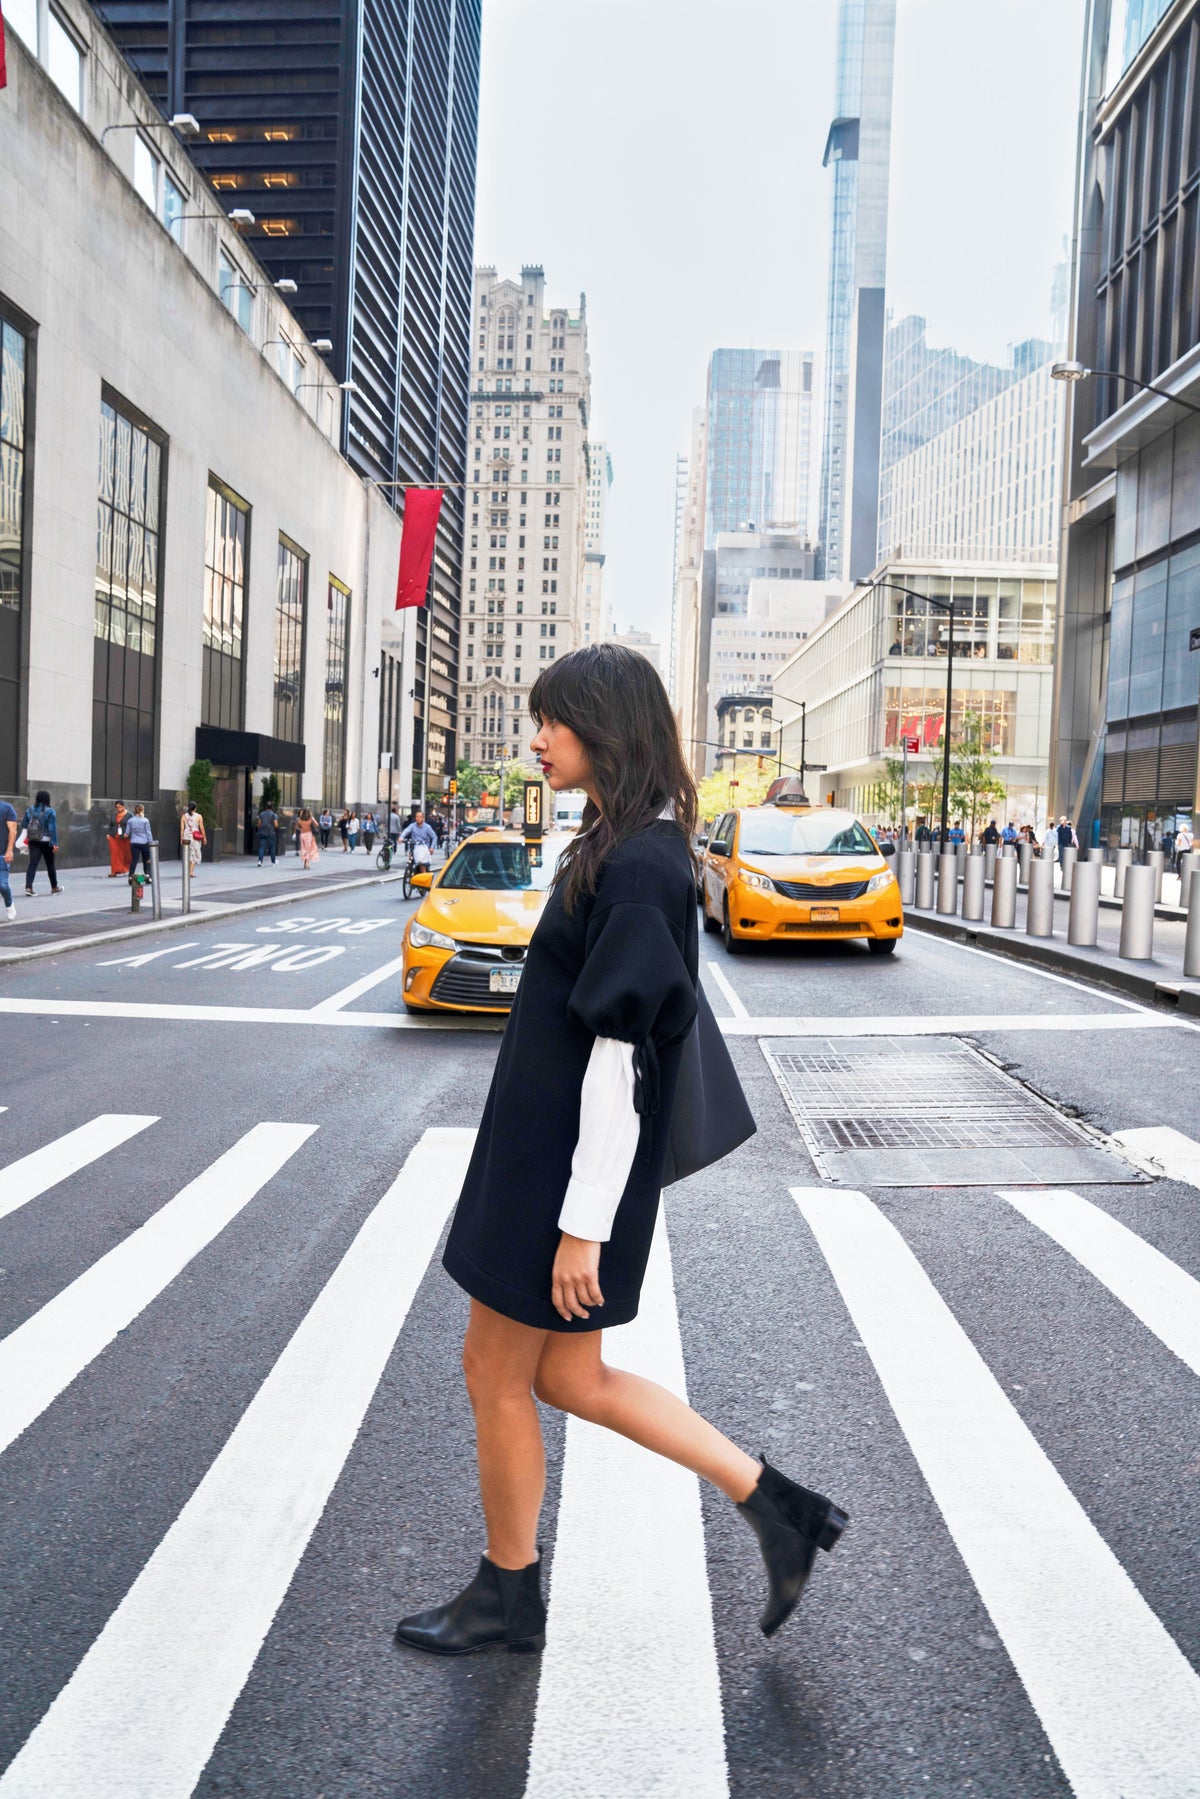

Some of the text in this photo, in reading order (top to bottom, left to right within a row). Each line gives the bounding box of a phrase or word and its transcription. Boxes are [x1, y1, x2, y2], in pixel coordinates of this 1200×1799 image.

[900, 715, 945, 748] HM
[256, 917, 397, 935] BUS
[95, 942, 346, 972] ONLY
